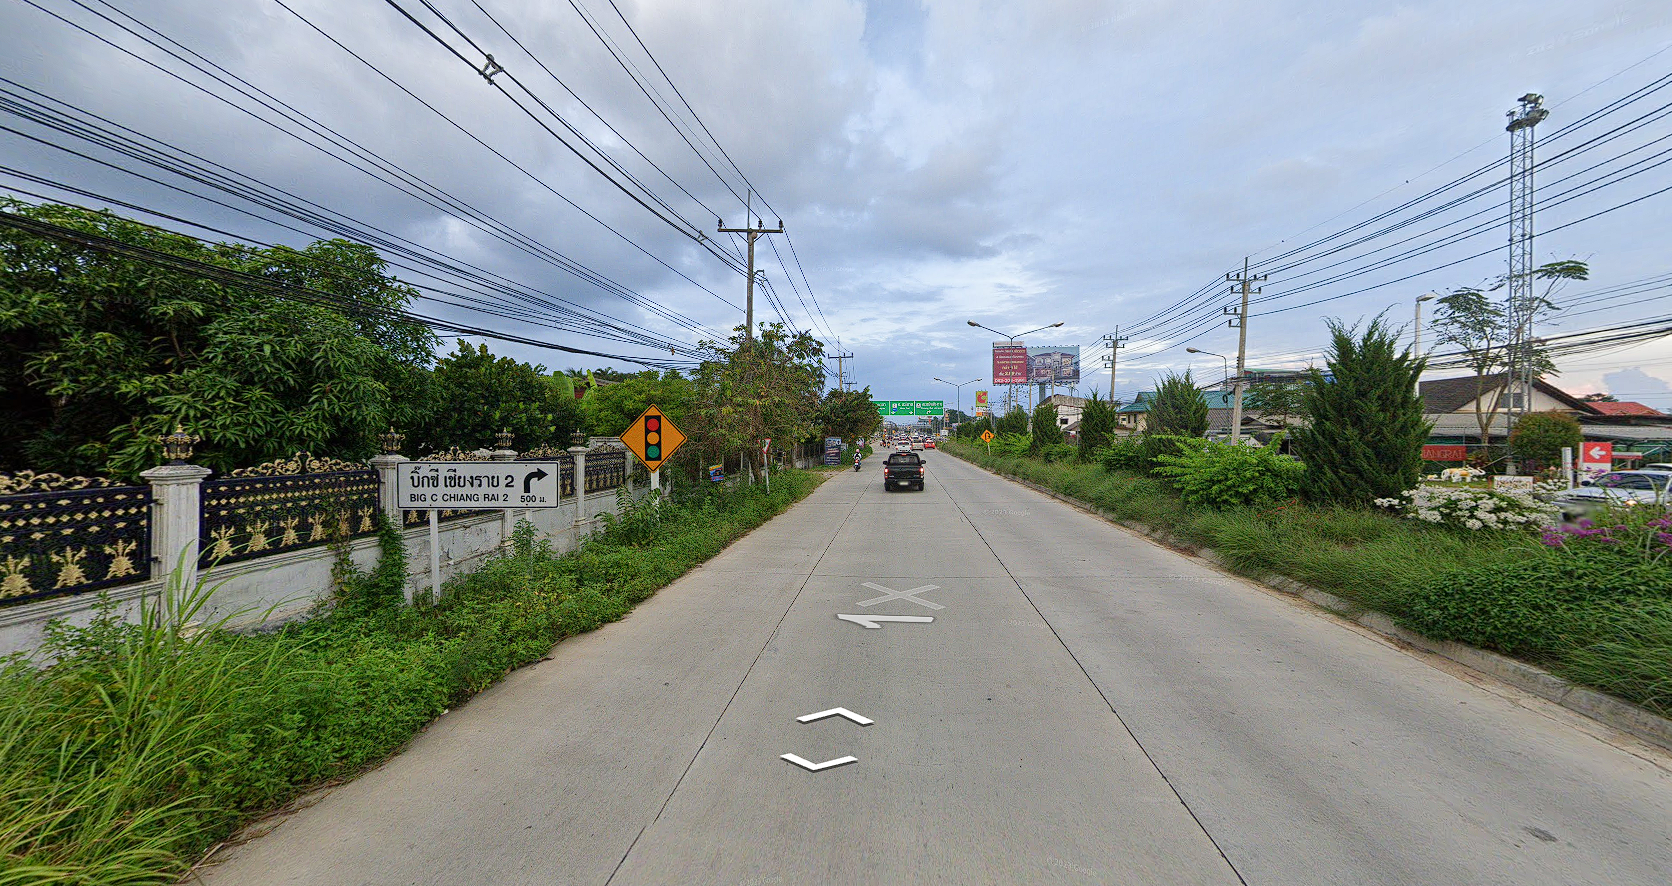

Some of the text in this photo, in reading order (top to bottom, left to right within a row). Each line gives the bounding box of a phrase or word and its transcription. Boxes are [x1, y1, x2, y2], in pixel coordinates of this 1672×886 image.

[410, 466, 515, 488] บิ๊กซี เชียงราย 2
[410, 494, 509, 502] BIG C CHIANG RAI 2
[520, 495, 537, 503] 500
